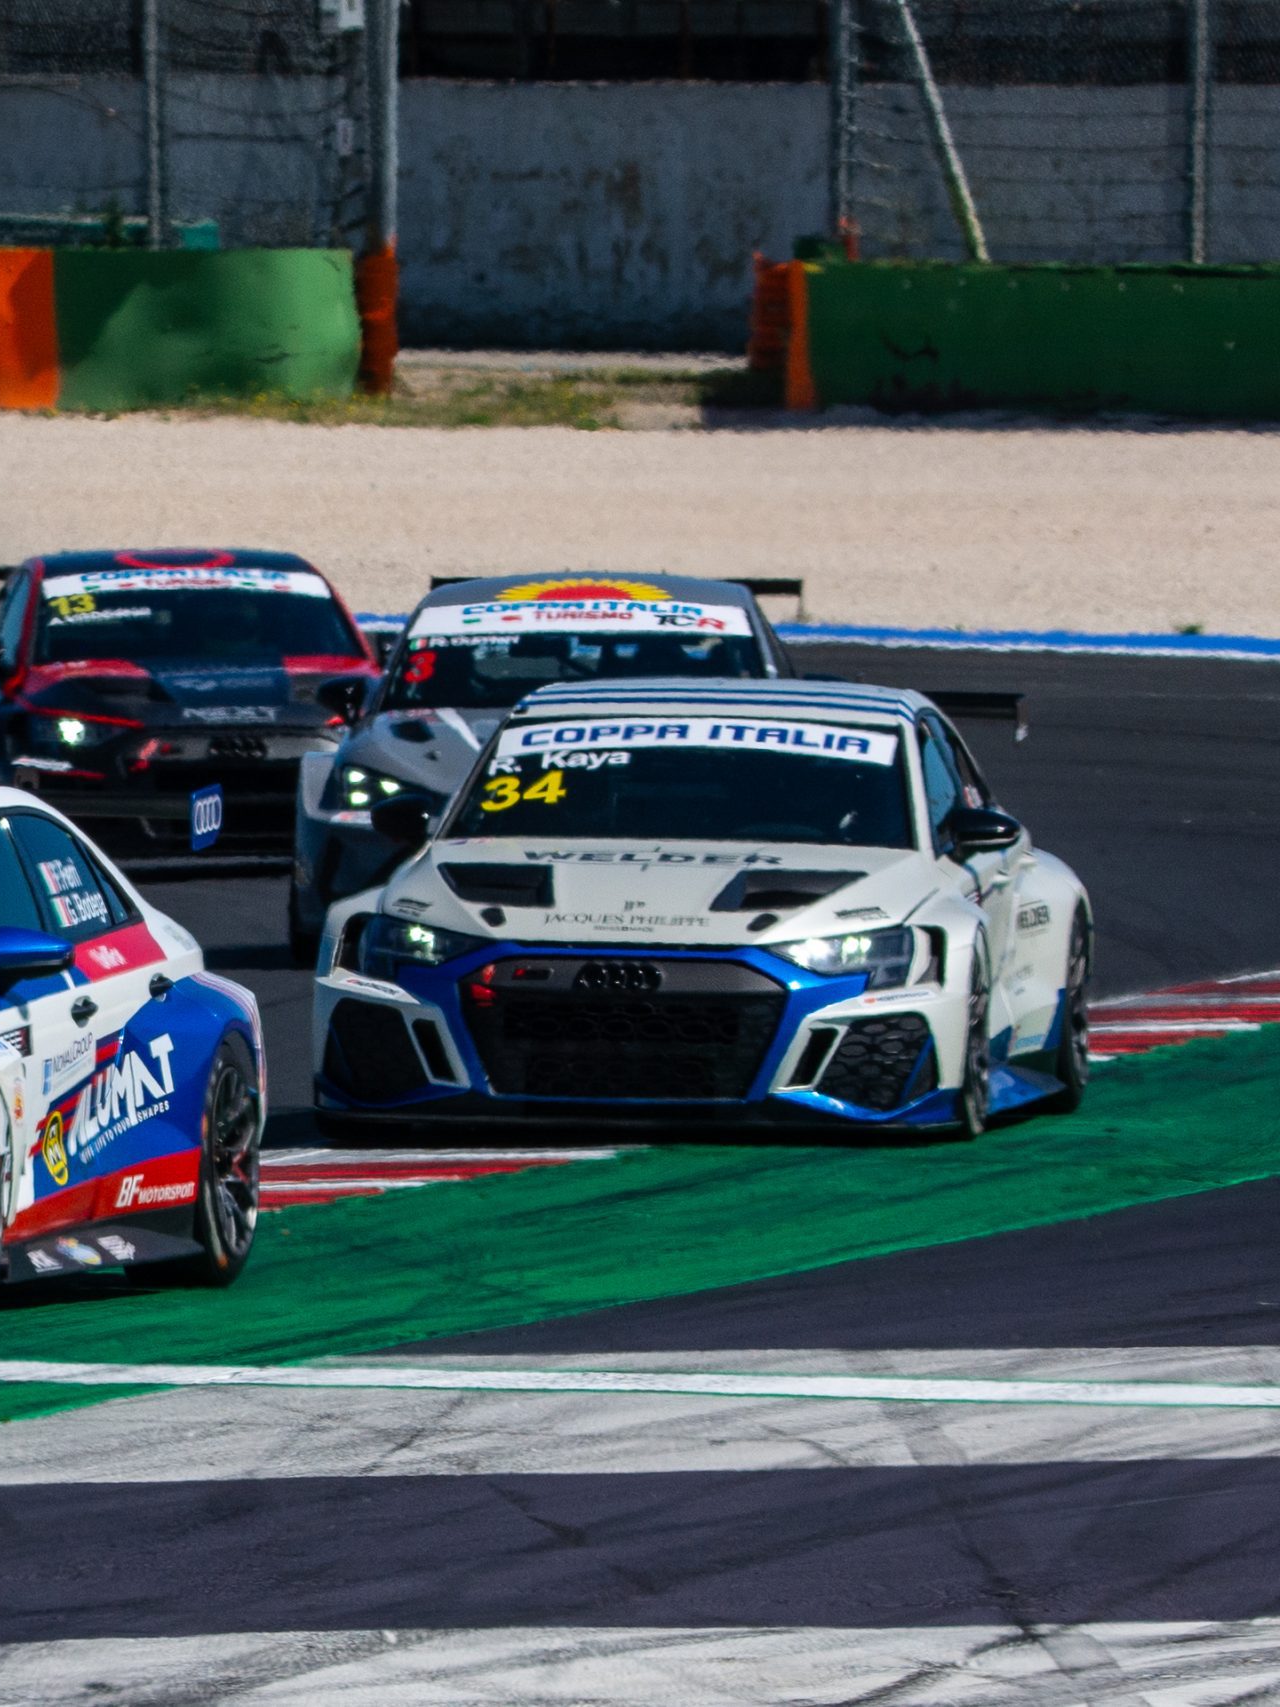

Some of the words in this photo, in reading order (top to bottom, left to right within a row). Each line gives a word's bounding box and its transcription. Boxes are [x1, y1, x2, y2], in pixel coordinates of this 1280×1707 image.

[48, 593, 97, 616] 13
[462, 601, 586, 615] COPPA
[591, 600, 703, 616] ITALIA
[533, 611, 633, 621] TURISMO
[653, 614, 726, 630] TCR
[404, 650, 437, 684] 3
[521, 724, 691, 747] COPPA
[708, 724, 872, 755] ITALIA
[487, 756, 523, 776] R.
[541, 748, 632, 771] Kaya
[479, 770, 568, 812] 34
[524, 850, 783, 866] WELDER
[544, 911, 625, 926] JACQUES
[136, 1100, 170, 1123] SHAPES
[114, 1173, 144, 1208] BF
